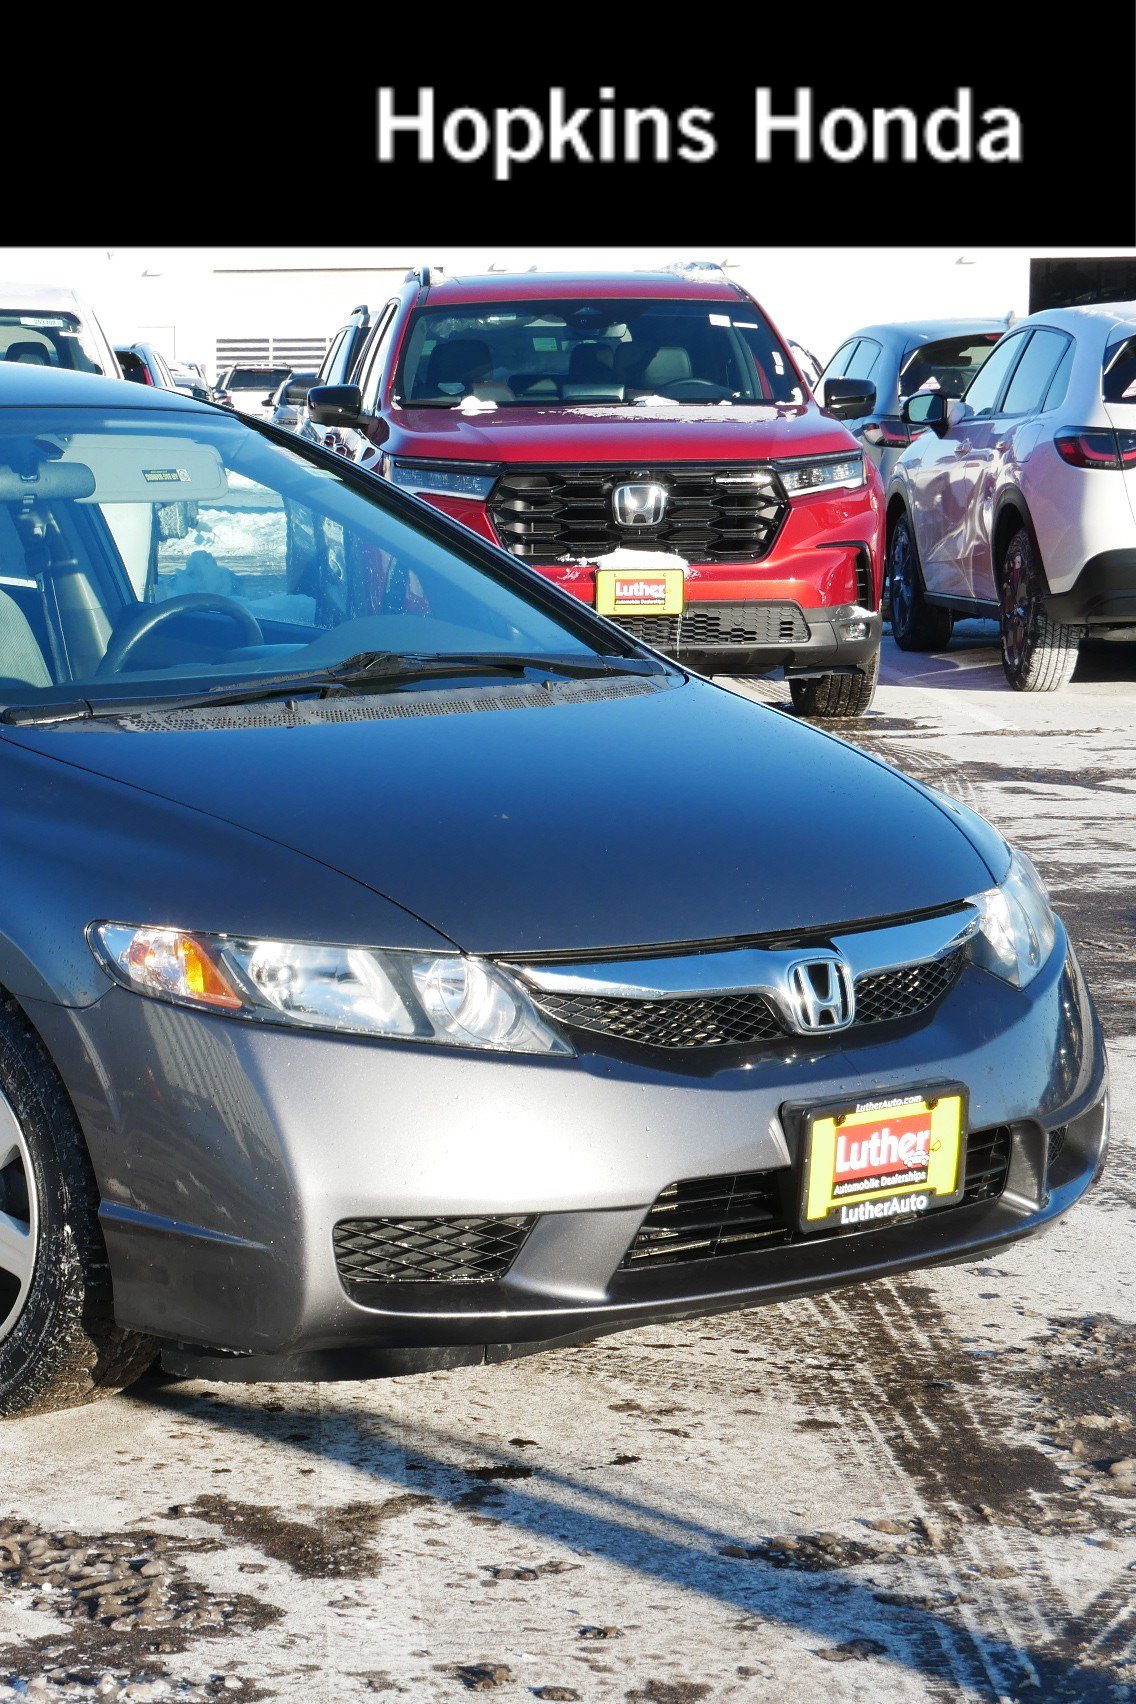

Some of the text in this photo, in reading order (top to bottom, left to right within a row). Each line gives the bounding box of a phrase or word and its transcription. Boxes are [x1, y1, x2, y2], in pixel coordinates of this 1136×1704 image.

[615, 581, 666, 597] Luther
[855, 1095, 923, 1113] LutherAuto.com
[835, 1127, 930, 1173] Luther
[833, 1170, 926, 1196] Automobile Dealerships
[840, 1195, 928, 1224] LutherAuto
